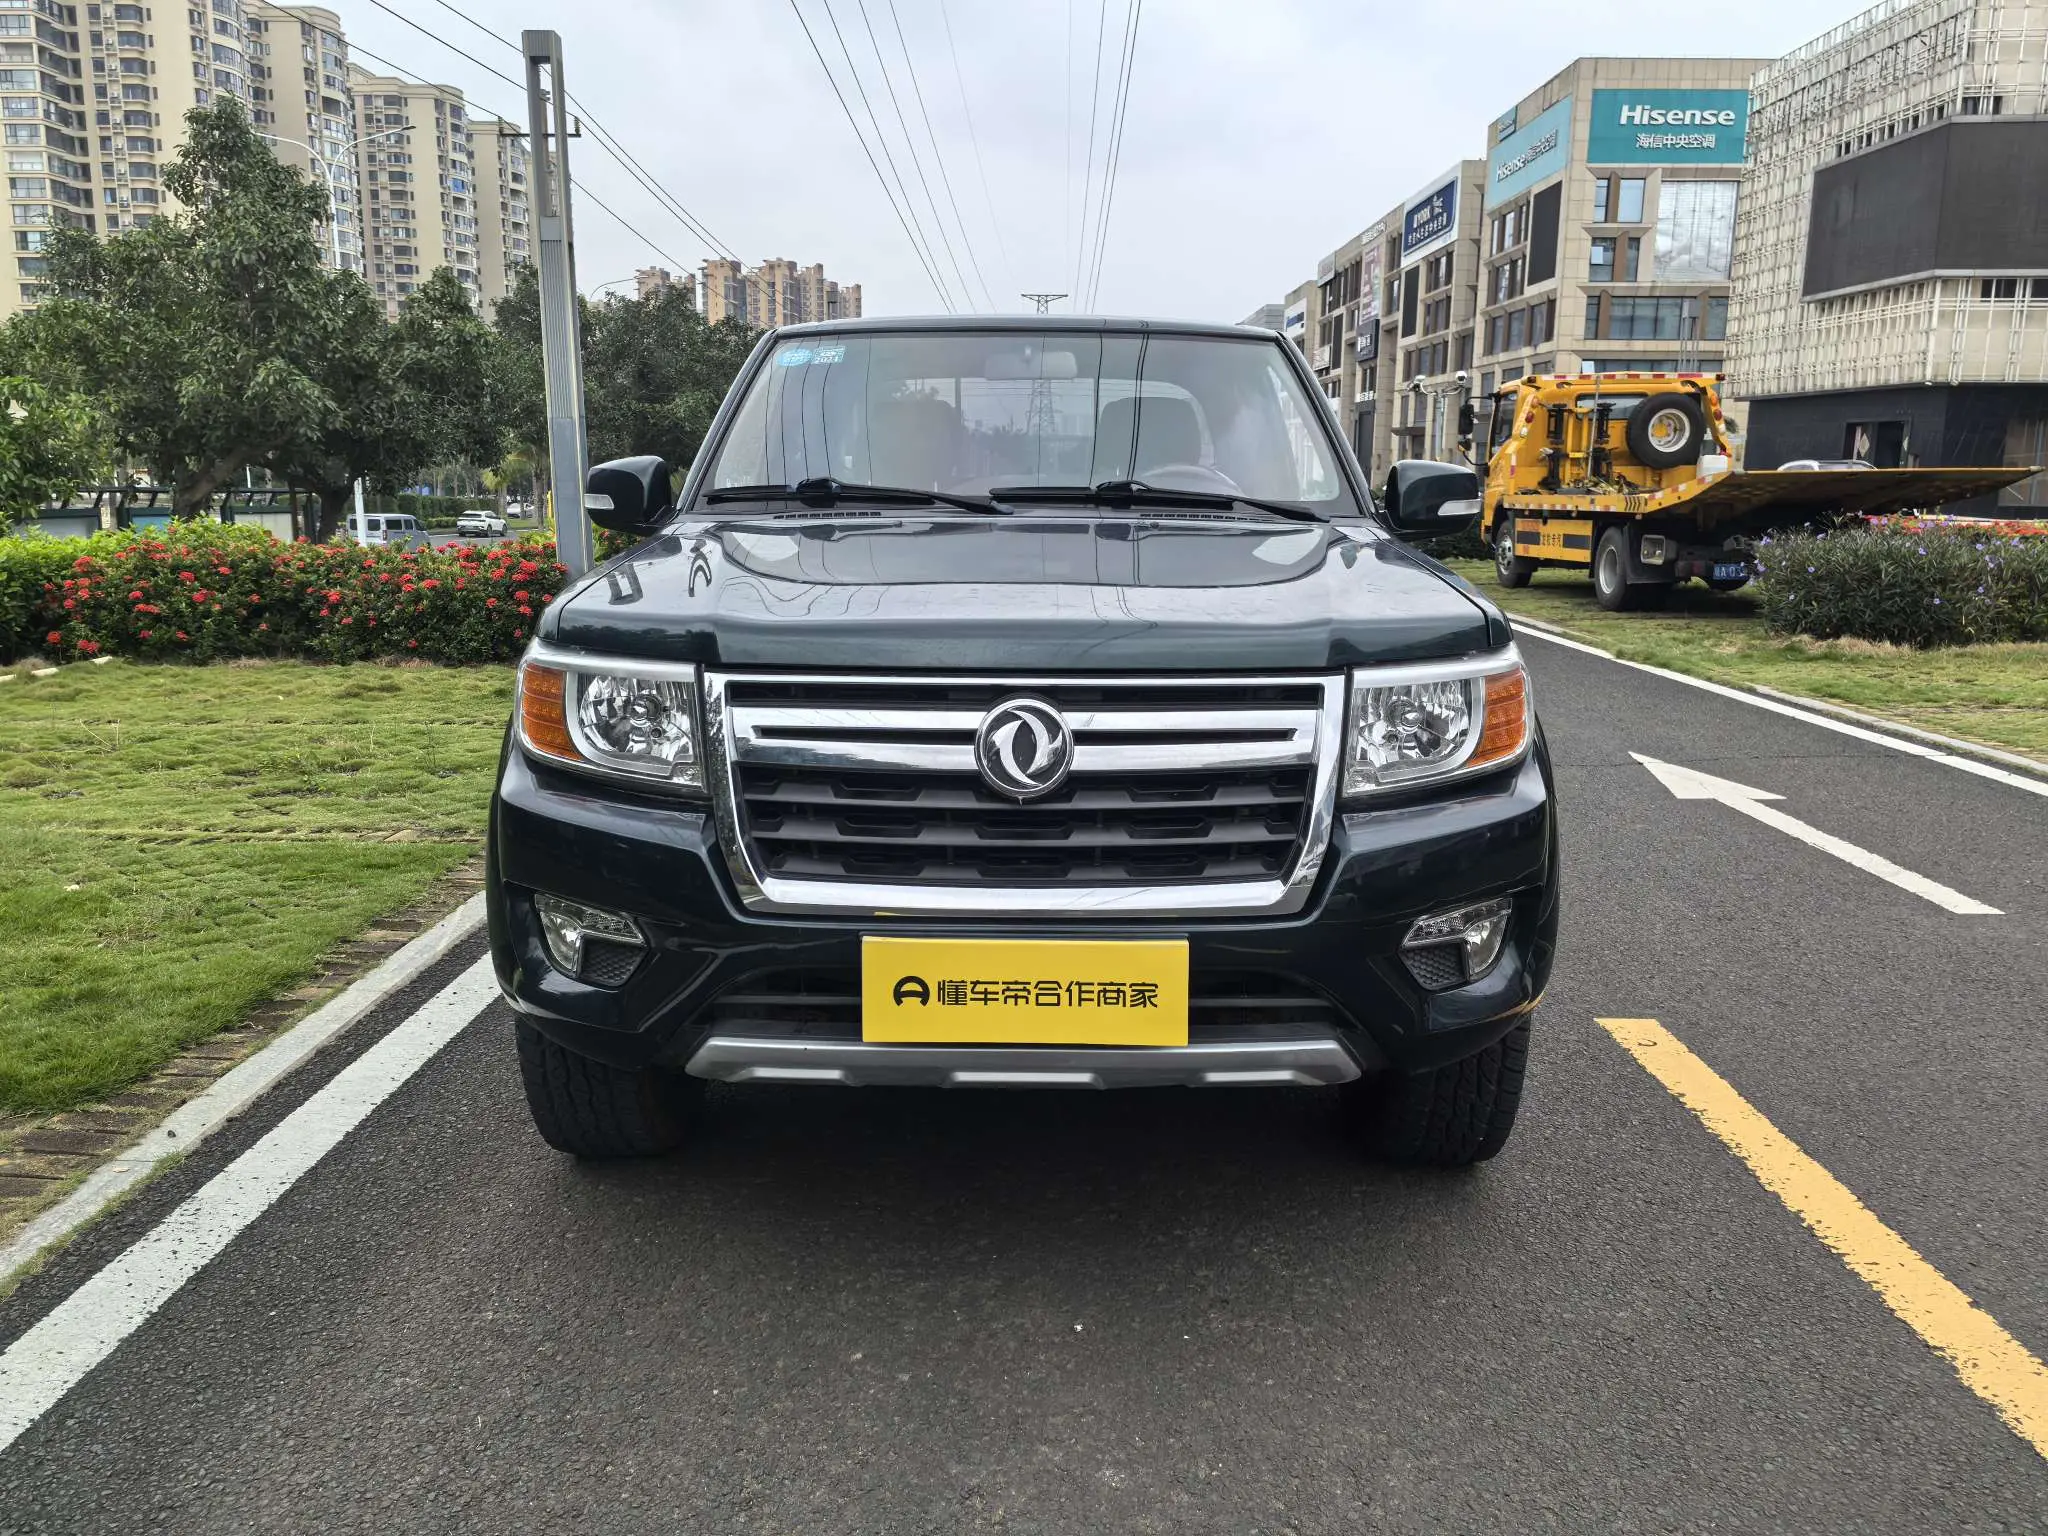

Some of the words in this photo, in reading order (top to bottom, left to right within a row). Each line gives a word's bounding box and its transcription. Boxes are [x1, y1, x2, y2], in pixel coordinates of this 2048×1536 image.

[1619, 104, 1736, 126] Hisense
[1636, 133, 1716, 149] 海信中央空调
[937, 979, 1159, 1009] 懂车帝合作商家
